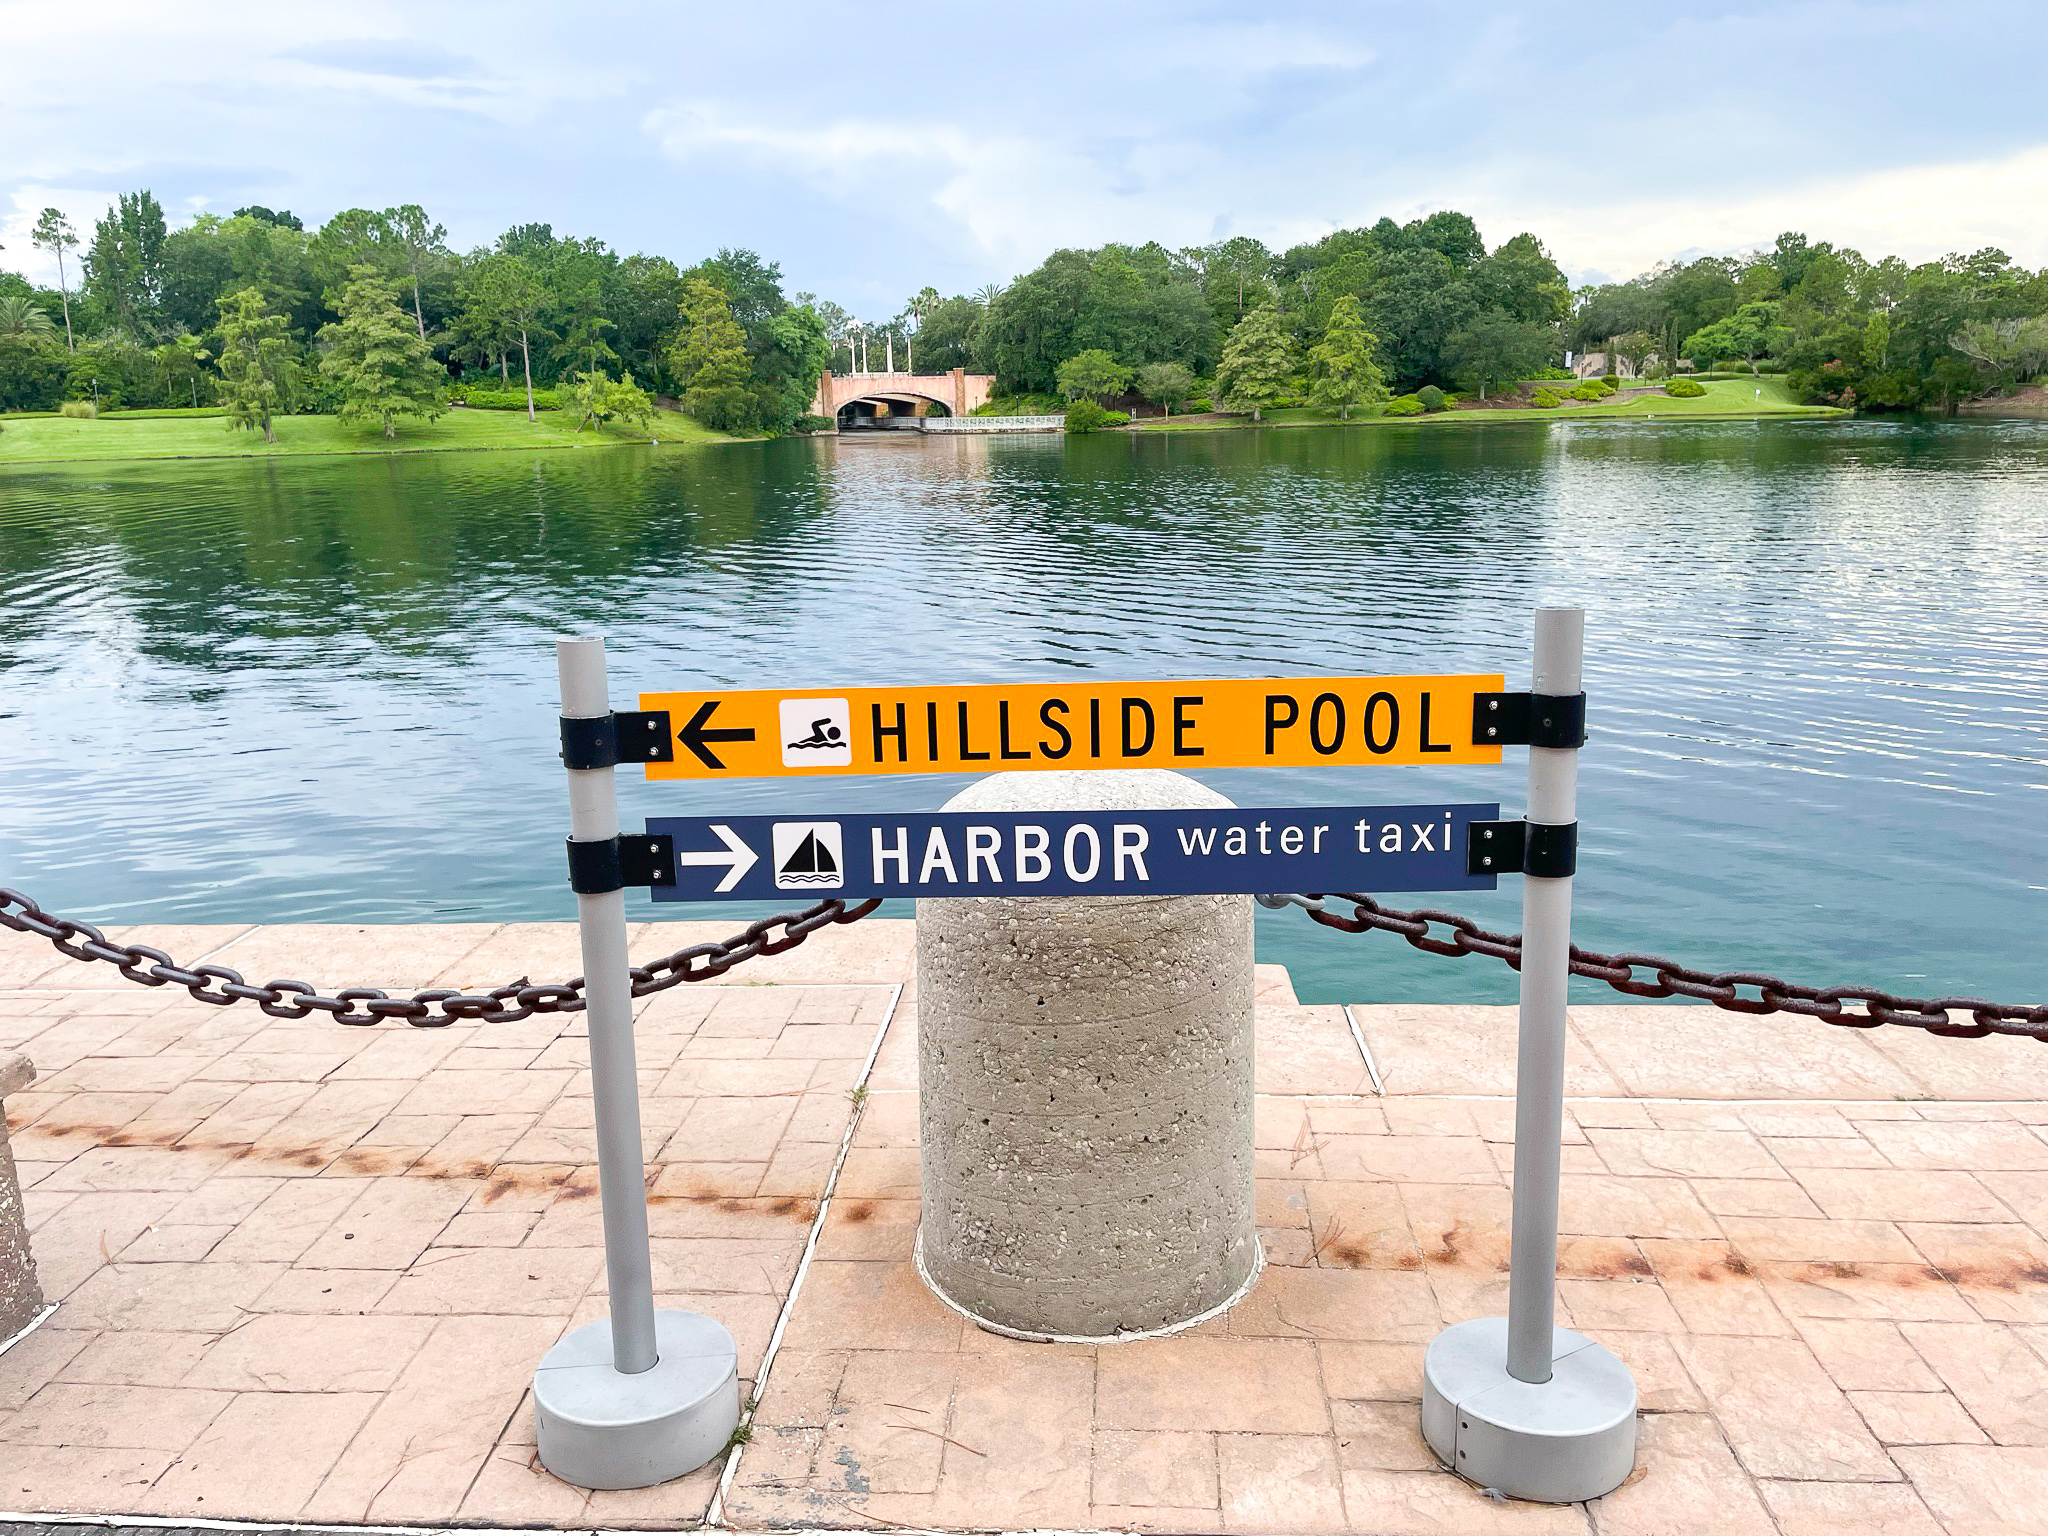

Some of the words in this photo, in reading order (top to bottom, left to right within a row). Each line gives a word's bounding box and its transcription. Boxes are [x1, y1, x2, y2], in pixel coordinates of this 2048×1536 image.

[871, 695, 1205, 763] HILLSIDE
[1264, 691, 1452, 755] POOL
[870, 822, 1151, 884] HARBOR
[1176, 819, 1330, 856] water
[1354, 811, 1452, 853] taxi
